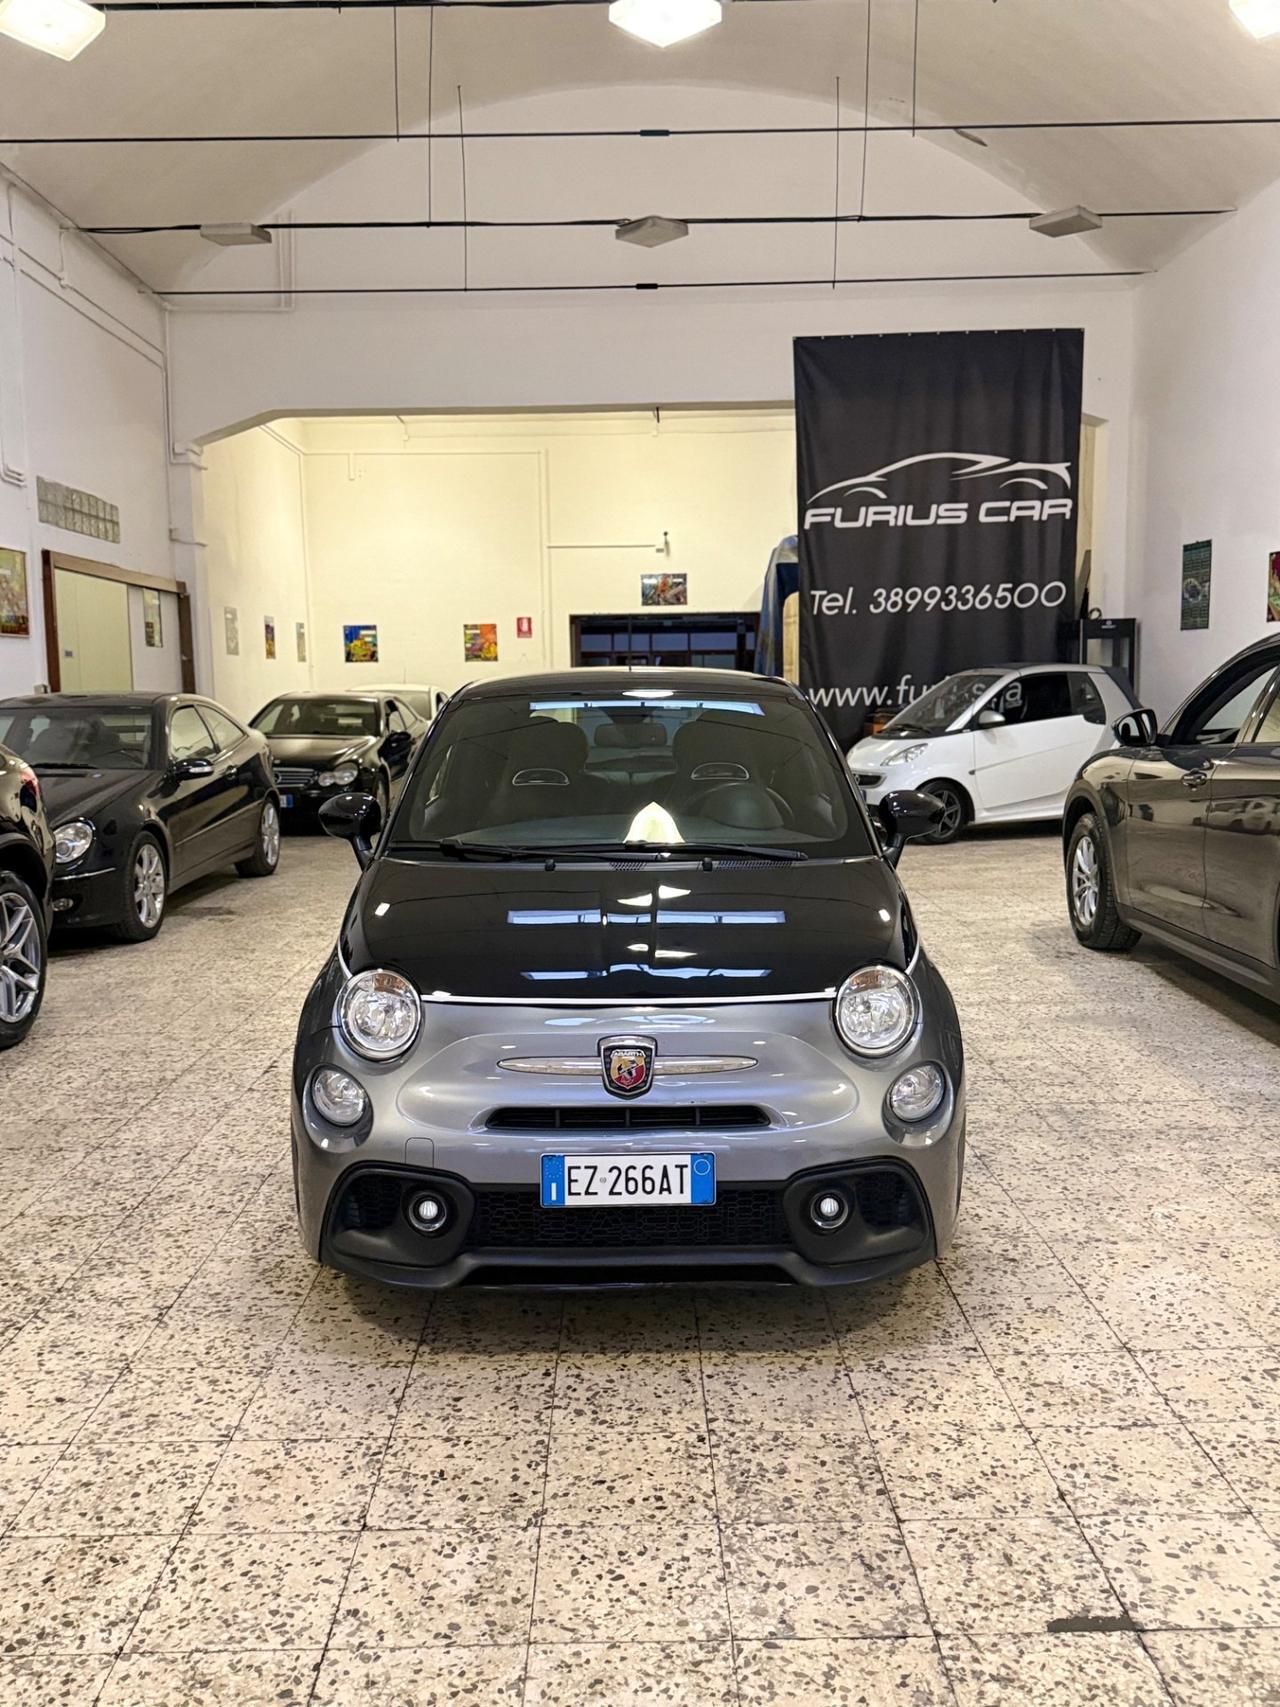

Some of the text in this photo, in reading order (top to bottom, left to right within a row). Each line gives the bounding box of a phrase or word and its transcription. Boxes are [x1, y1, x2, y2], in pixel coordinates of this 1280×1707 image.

[803, 498, 1074, 530] FURIUS CAR
[810, 580, 1067, 616] Tel. 3899336500
[567, 1164, 689, 1196] EZ 266AT
